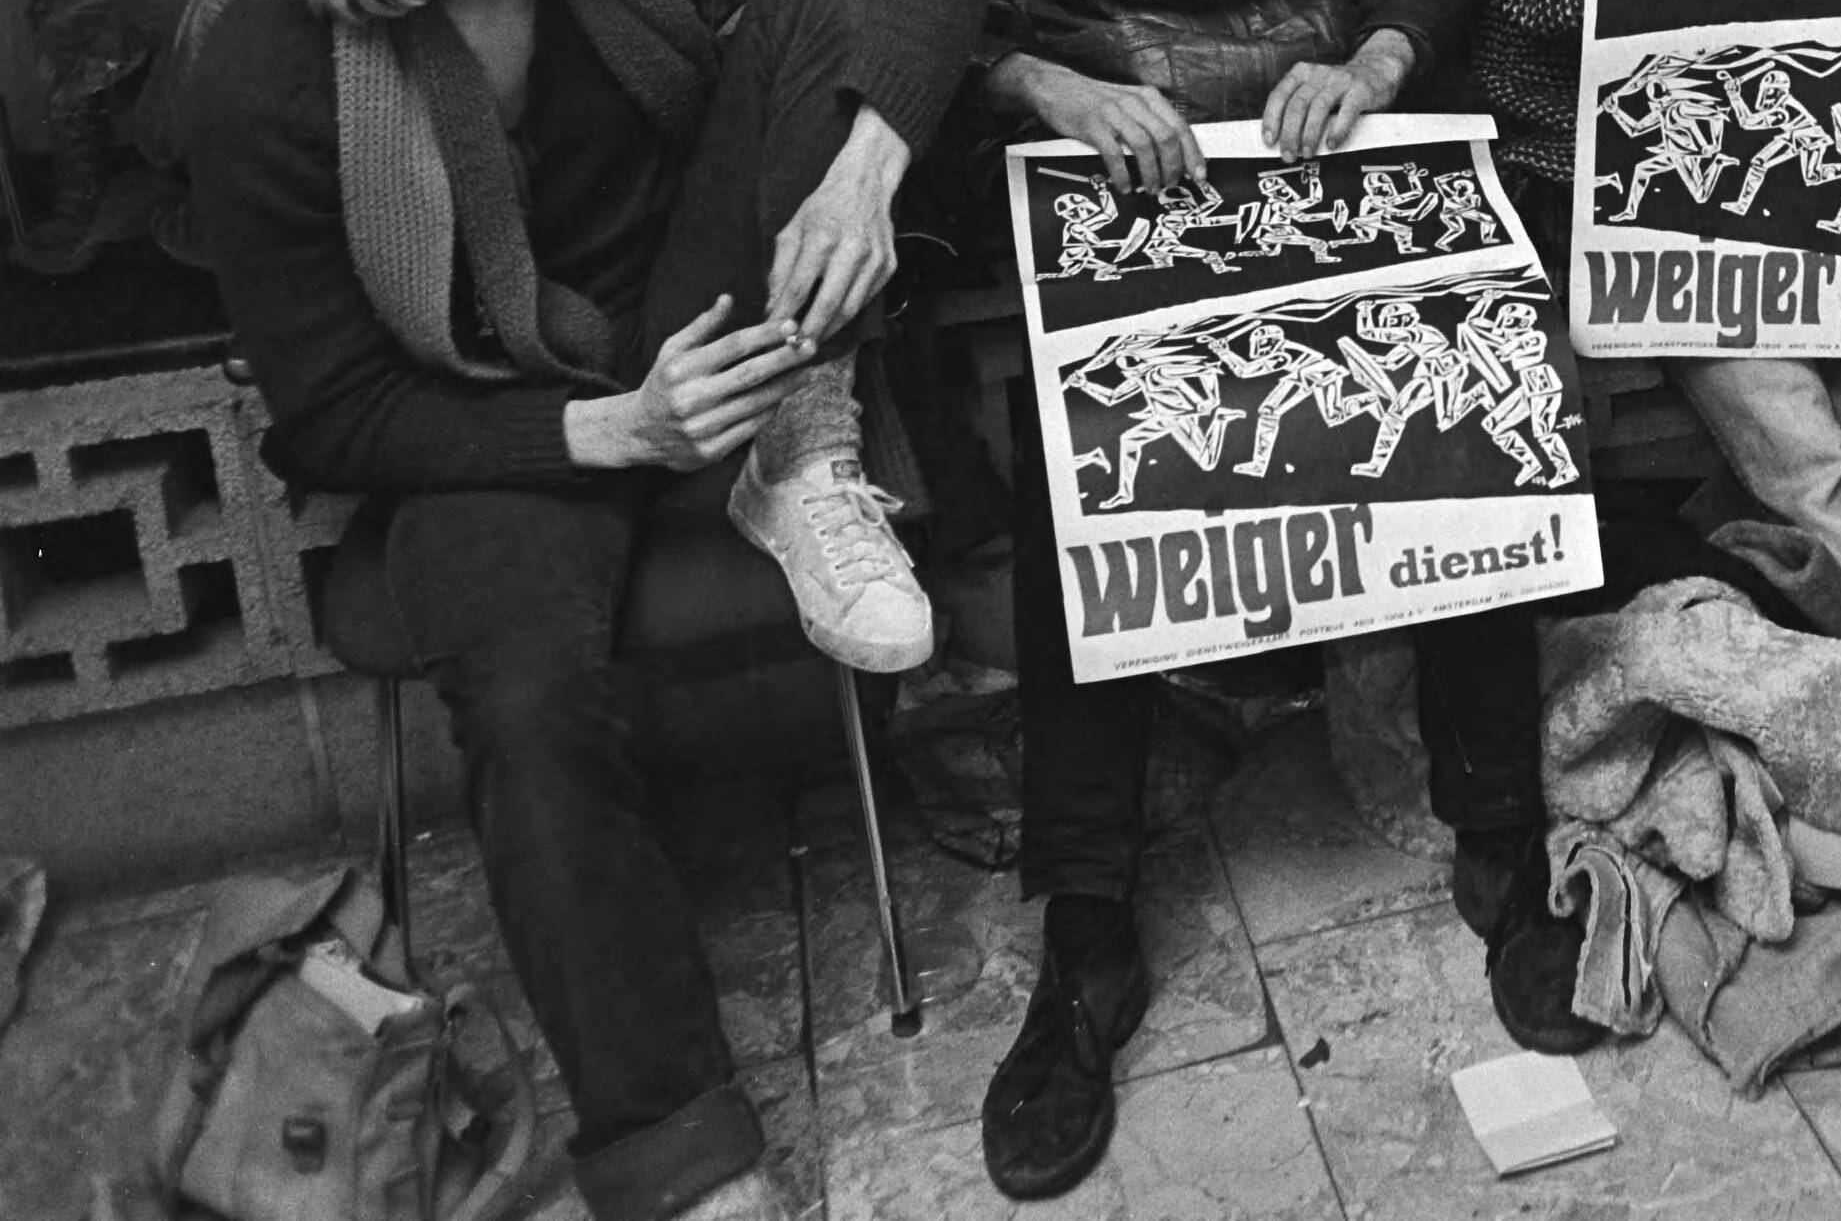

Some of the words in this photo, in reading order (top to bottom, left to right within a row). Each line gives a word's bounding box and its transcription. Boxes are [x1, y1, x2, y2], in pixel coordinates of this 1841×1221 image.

[1584, 237, 1837, 348] weiger
[1067, 504, 1373, 639] weiger
[1389, 513, 1566, 589] dienst!
[1432, 595, 1493, 613] AMSTERDAM
